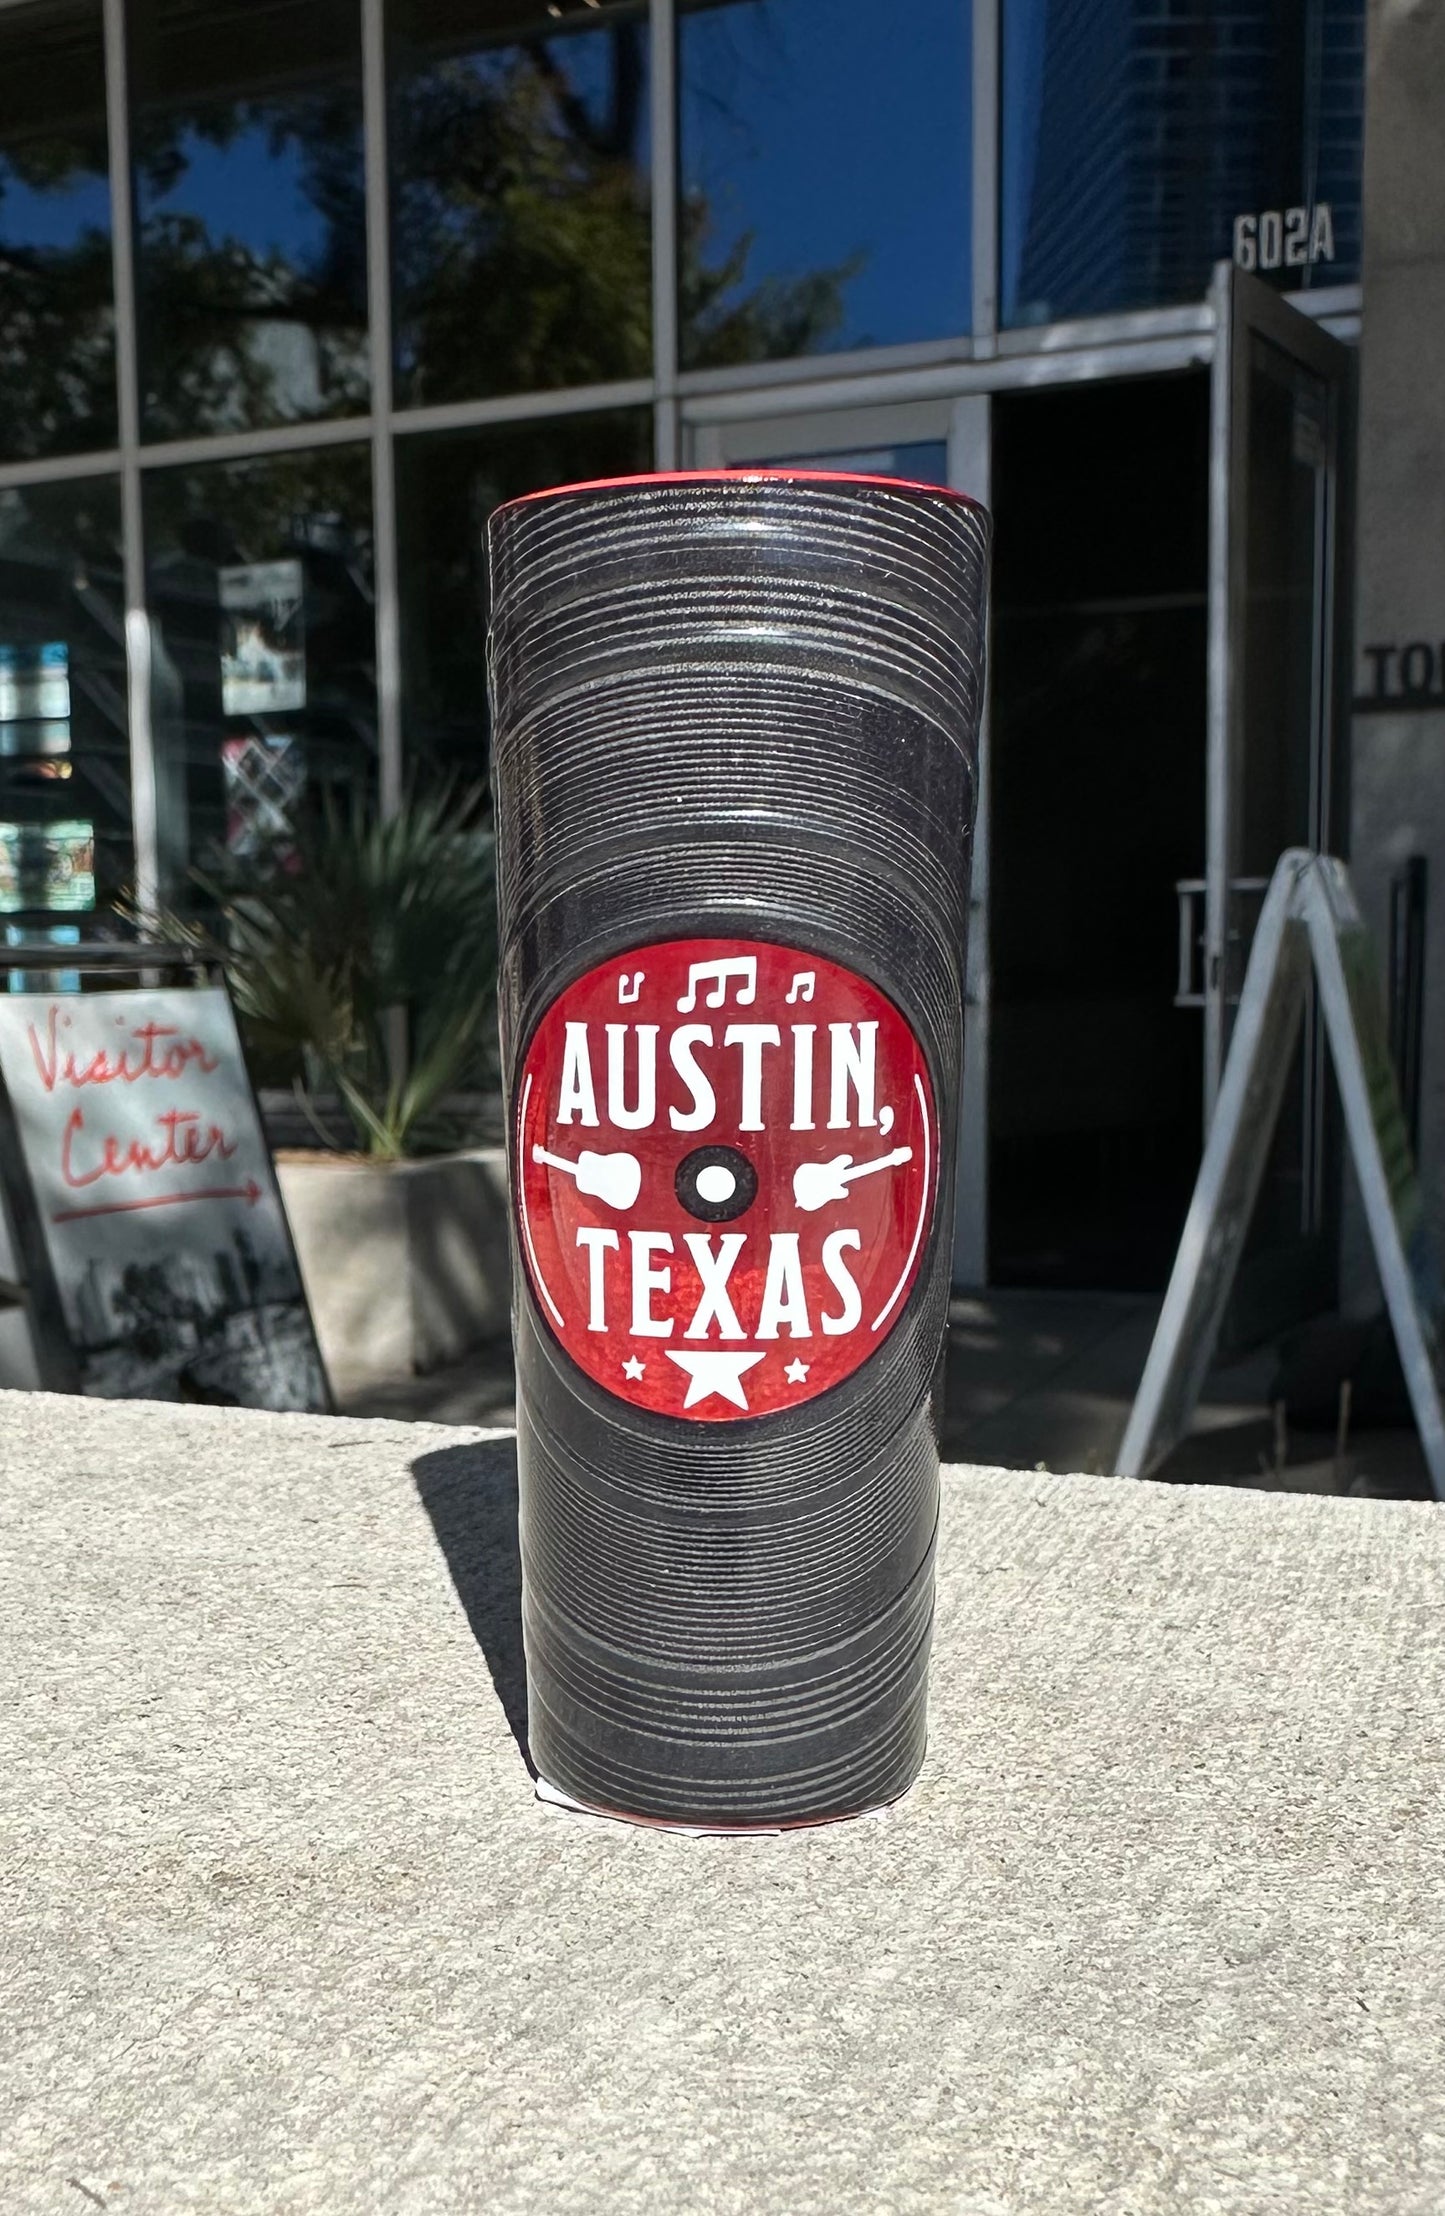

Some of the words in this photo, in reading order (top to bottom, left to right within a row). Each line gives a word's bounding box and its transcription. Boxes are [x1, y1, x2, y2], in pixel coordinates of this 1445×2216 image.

[1233, 203, 1335, 271] 602A
[1362, 642, 1445, 698] TO
[28, 1004, 219, 1092] Visitor
[556, 1020, 895, 1135] AUSTIN,
[62, 1107, 239, 1188] Center
[576, 1226, 862, 1340] TEXAS
